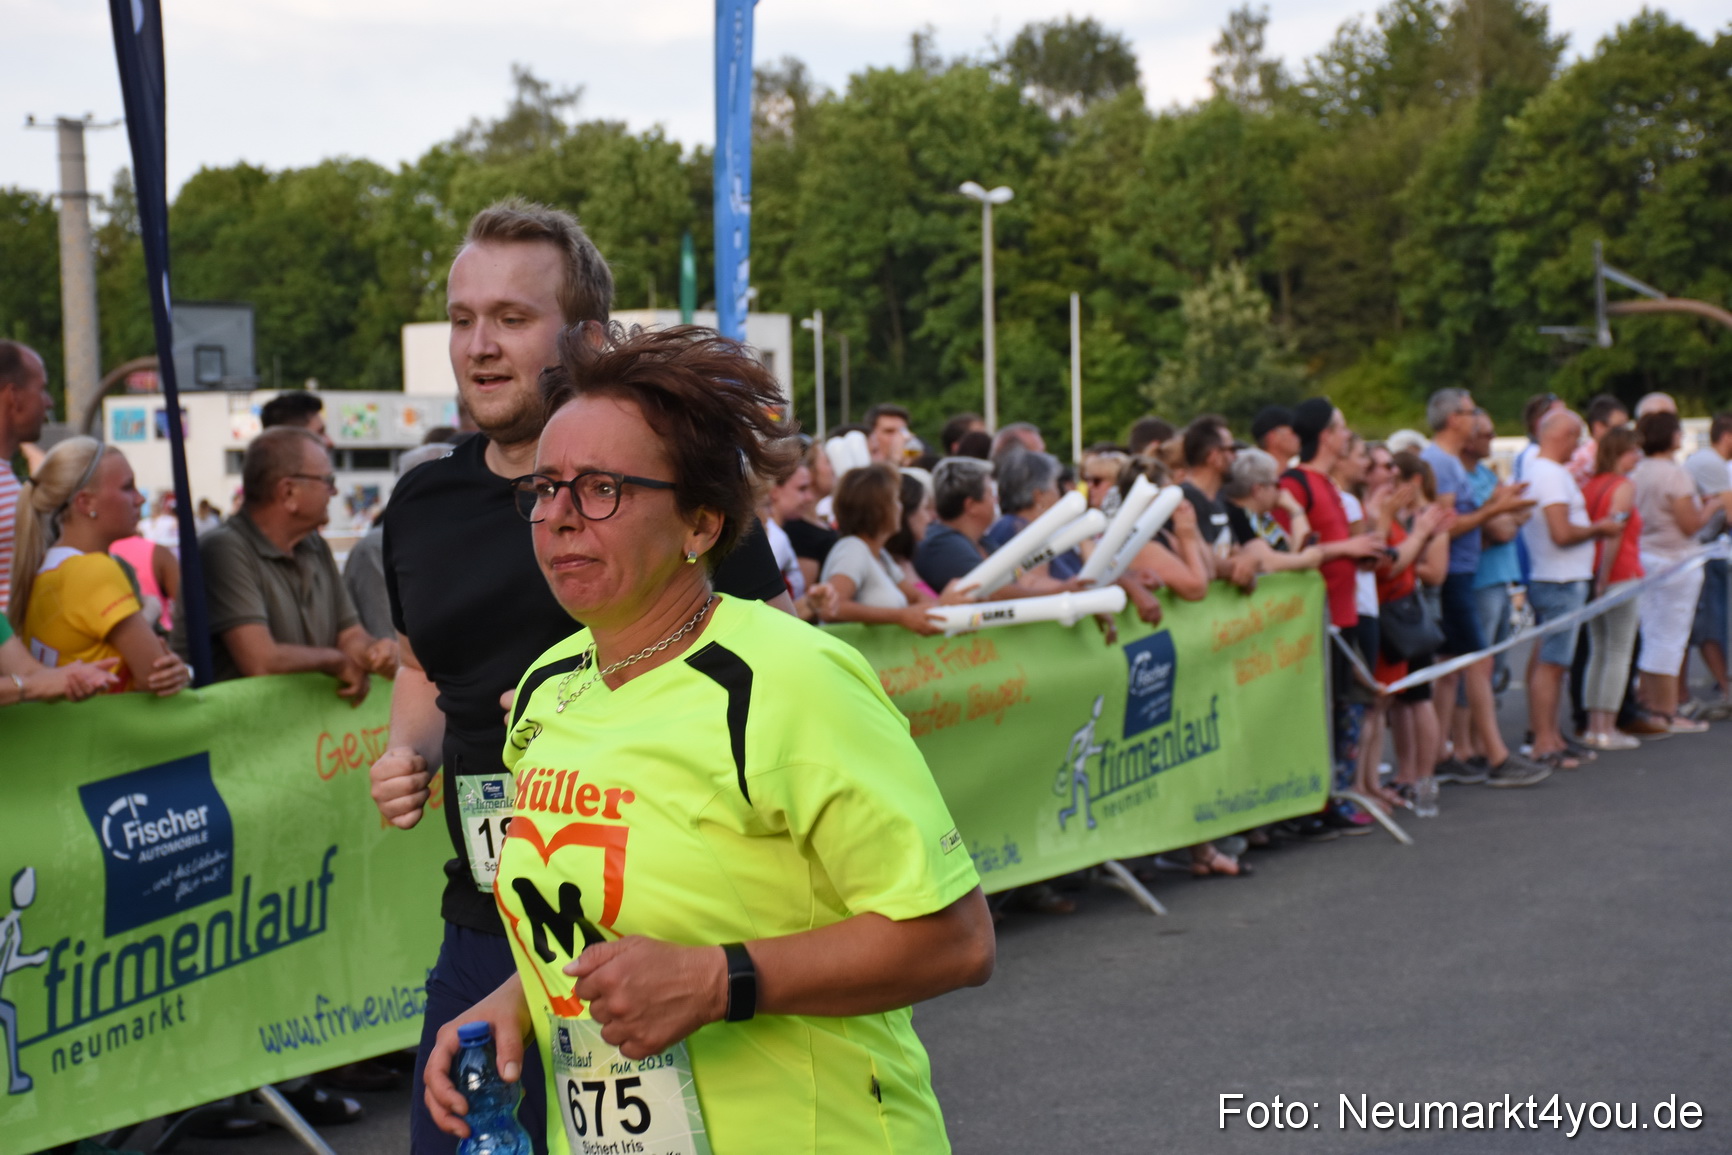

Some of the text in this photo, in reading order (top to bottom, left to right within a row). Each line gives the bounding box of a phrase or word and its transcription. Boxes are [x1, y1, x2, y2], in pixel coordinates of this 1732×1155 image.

[1099, 693, 1220, 799] firmenlauf
[122, 804, 208, 850] Fischer
[138, 830, 208, 863] AUTOMOBILE
[44, 844, 338, 1035] firmenlauf
[52, 993, 186, 1074] neumarkt
[638, 1053, 674, 1072] 2019
[567, 1076, 652, 1137] 675
[621, 1139, 644, 1154] Iris
